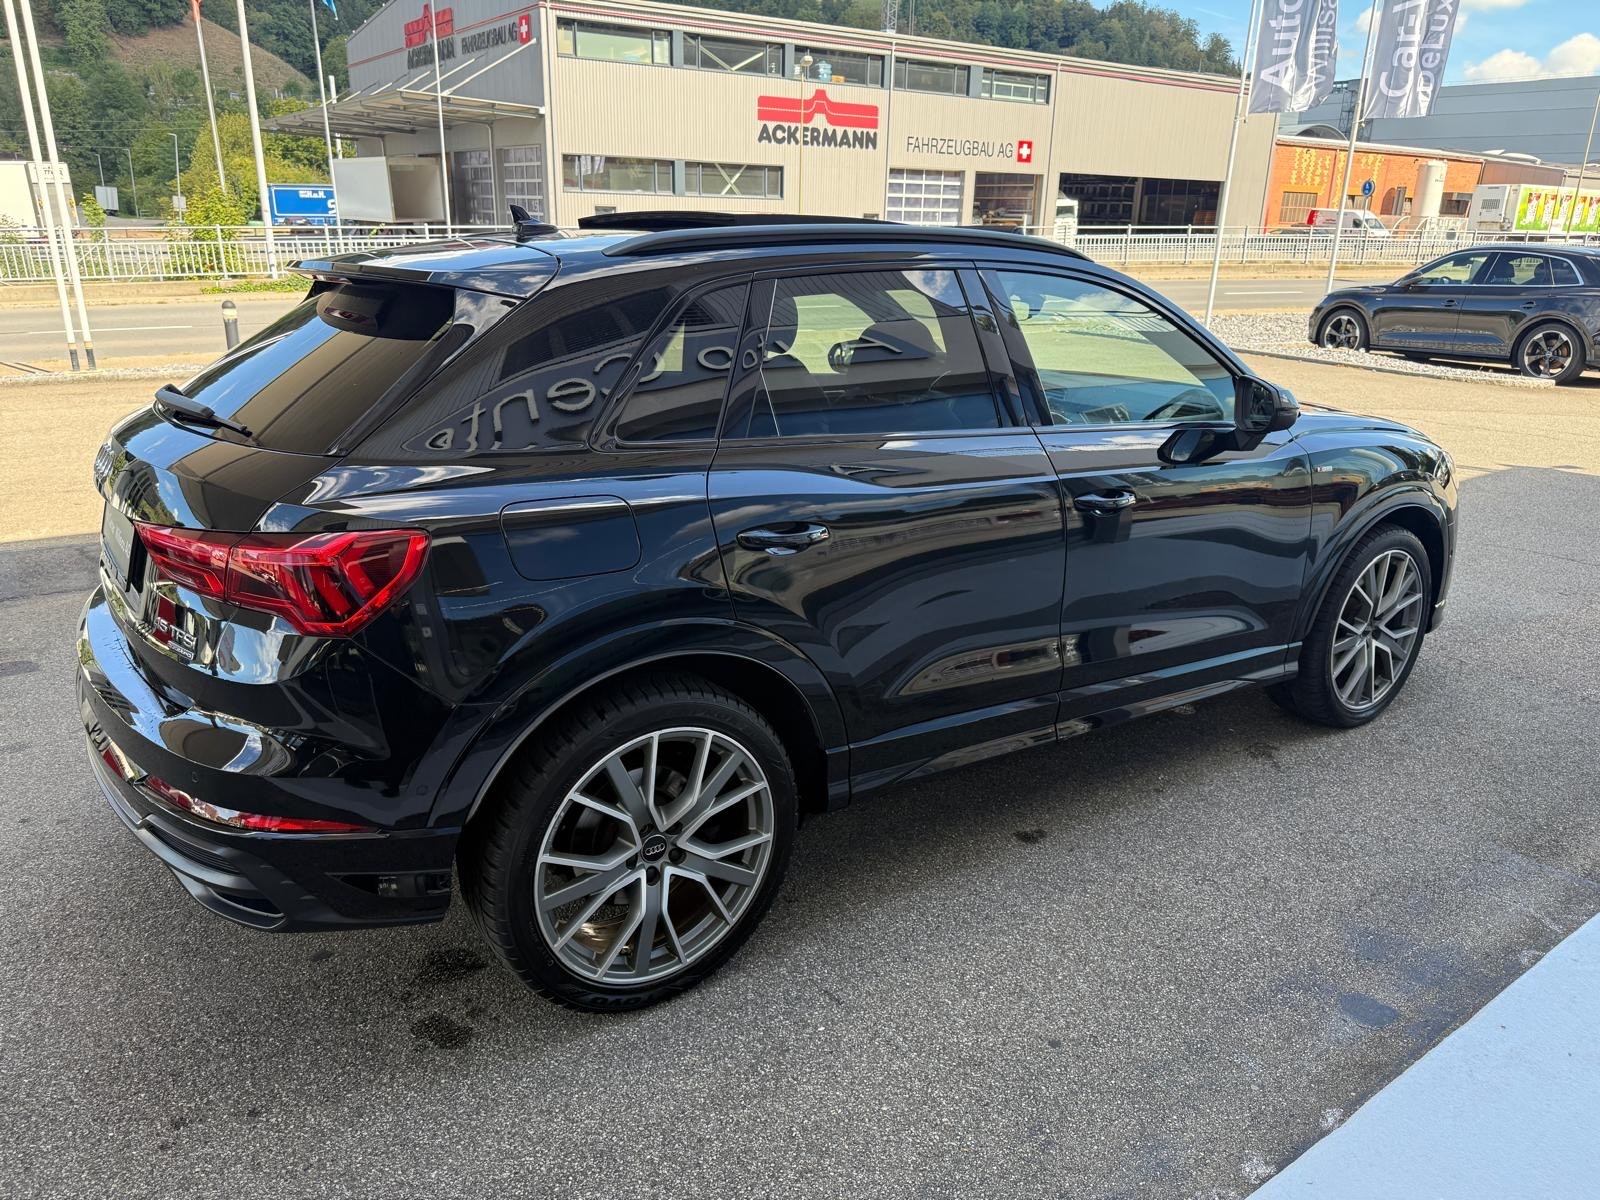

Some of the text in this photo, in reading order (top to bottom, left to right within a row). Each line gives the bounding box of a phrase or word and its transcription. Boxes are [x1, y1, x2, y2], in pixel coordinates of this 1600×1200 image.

[757, 123, 878, 150] ACKERMANN
[906, 136, 1014, 158] FAHRZEUGBAU AG
[170, 624, 197, 650] TFSI
